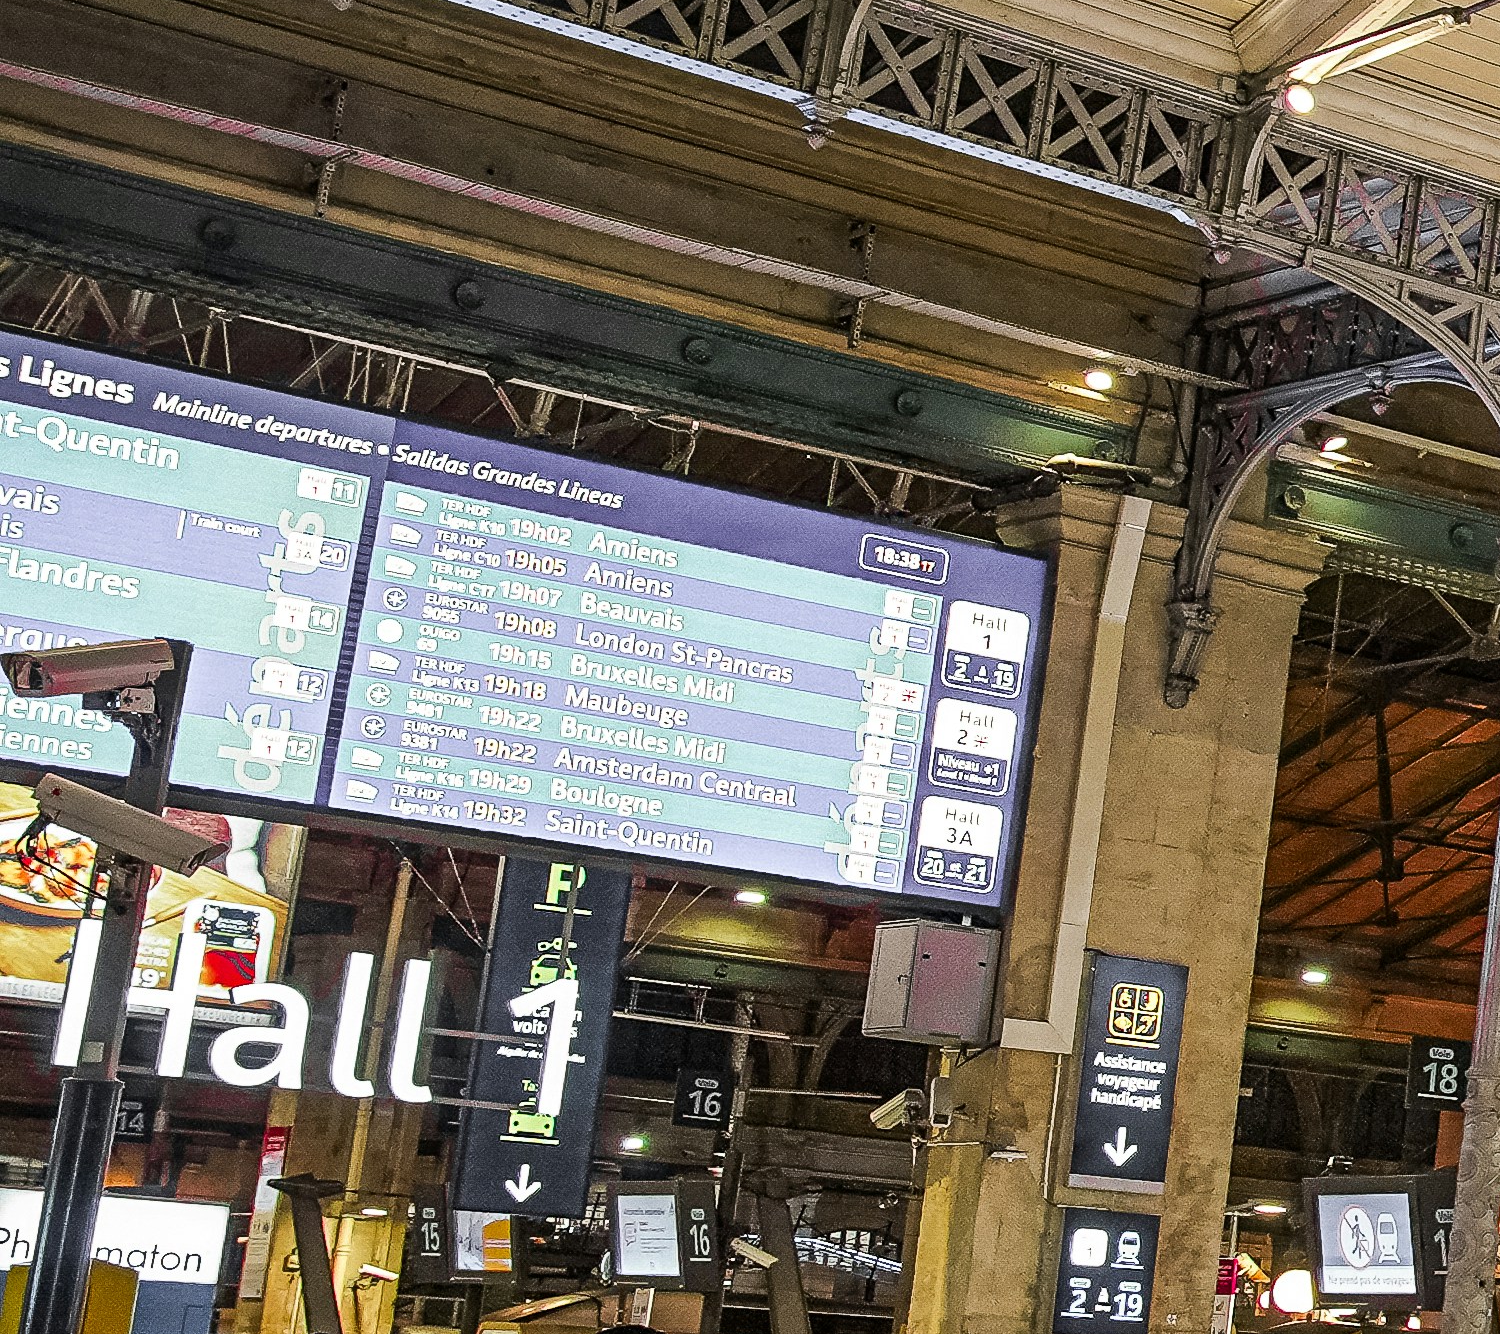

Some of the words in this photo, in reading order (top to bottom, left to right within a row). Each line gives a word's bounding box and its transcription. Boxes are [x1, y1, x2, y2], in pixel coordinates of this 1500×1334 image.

[19, 355, 134, 403] Lignes
[153, 392, 252, 429] Mainline
[255, 416, 373, 457] departures
[392, 445, 469, 475] Salidas
[473, 462, 556, 494] Grandes
[0, 412, 180, 469] t-Quentin
[442, 498, 464, 512] TER
[466, 504, 491, 517] HDF
[191, 513, 223, 530] Train
[225, 519, 260, 537] court
[436, 529, 458, 544] TER
[460, 535, 486, 548] HDF
[439, 512, 477, 530] Ligne
[510, 519, 571, 546] 19h02
[588, 532, 678, 567] Amiens
[321, 545, 344, 563] 20
[874, 546, 920, 569] 18:38
[431, 561, 453, 575] TER
[455, 566, 481, 579] HDF
[433, 543, 471, 564] Ligne
[505, 550, 566, 576] 19h05
[584, 562, 672, 598] Amiens
[425, 593, 488, 614] EUROSTAR
[500, 581, 562, 607] 19h07
[581, 592, 683, 631] Beauvais
[420, 625, 460, 641] OUIGO
[972, 612, 1008, 632] Hall
[494, 612, 556, 638] 19h08
[576, 623, 664, 659] London
[671, 642, 792, 683] St-Pancras
[983, 634, 991, 650] 1
[415, 656, 437, 670] TER
[439, 660, 465, 674] HDF
[489, 643, 551, 669] 19h15
[571, 654, 678, 692] Bruxelles
[683, 675, 735, 703] Midi
[409, 688, 472, 708] EUROSTAR
[412, 670, 450, 691] Ligne
[484, 674, 546, 700] 19h18
[565, 685, 688, 728] Maubeuge
[403, 720, 467, 740] EUROSTAR
[960, 709, 994, 728] Hall
[479, 706, 541, 732] 19h22
[561, 716, 668, 753] Bruxelles
[674, 736, 725, 763] Midi
[957, 730, 968, 745] 2
[289, 739, 312, 758] 12
[398, 752, 421, 765] TER
[423, 756, 449, 769] HDF
[474, 737, 536, 763] 19h22
[554, 748, 692, 789] Amsterdam
[700, 772, 795, 806] Centraal
[393, 784, 416, 797] TER
[417, 788, 444, 801] HDF
[469, 769, 531, 794] 19h29
[551, 778, 662, 819] Boulogne
[463, 801, 526, 826] 19h32
[545, 810, 712, 855] Saint-Quentin
[945, 807, 980, 825] Hall
[946, 828, 973, 846] 3A
[51, 917, 432, 1103] Hall
[508, 978, 578, 1117] 1
[1094, 1051, 1166, 1075] Assistance
[1097, 1072, 1160, 1093] voyageur
[1423, 1062, 1458, 1094] 18
[688, 1091, 722, 1118] 16
[1090, 1088, 1163, 1112] handicapé
[421, 1222, 440, 1251] 15
[690, 1224, 710, 1256] 16
[1068, 1288, 1087, 1312] 2
[1114, 1293, 1144, 1317] 19
